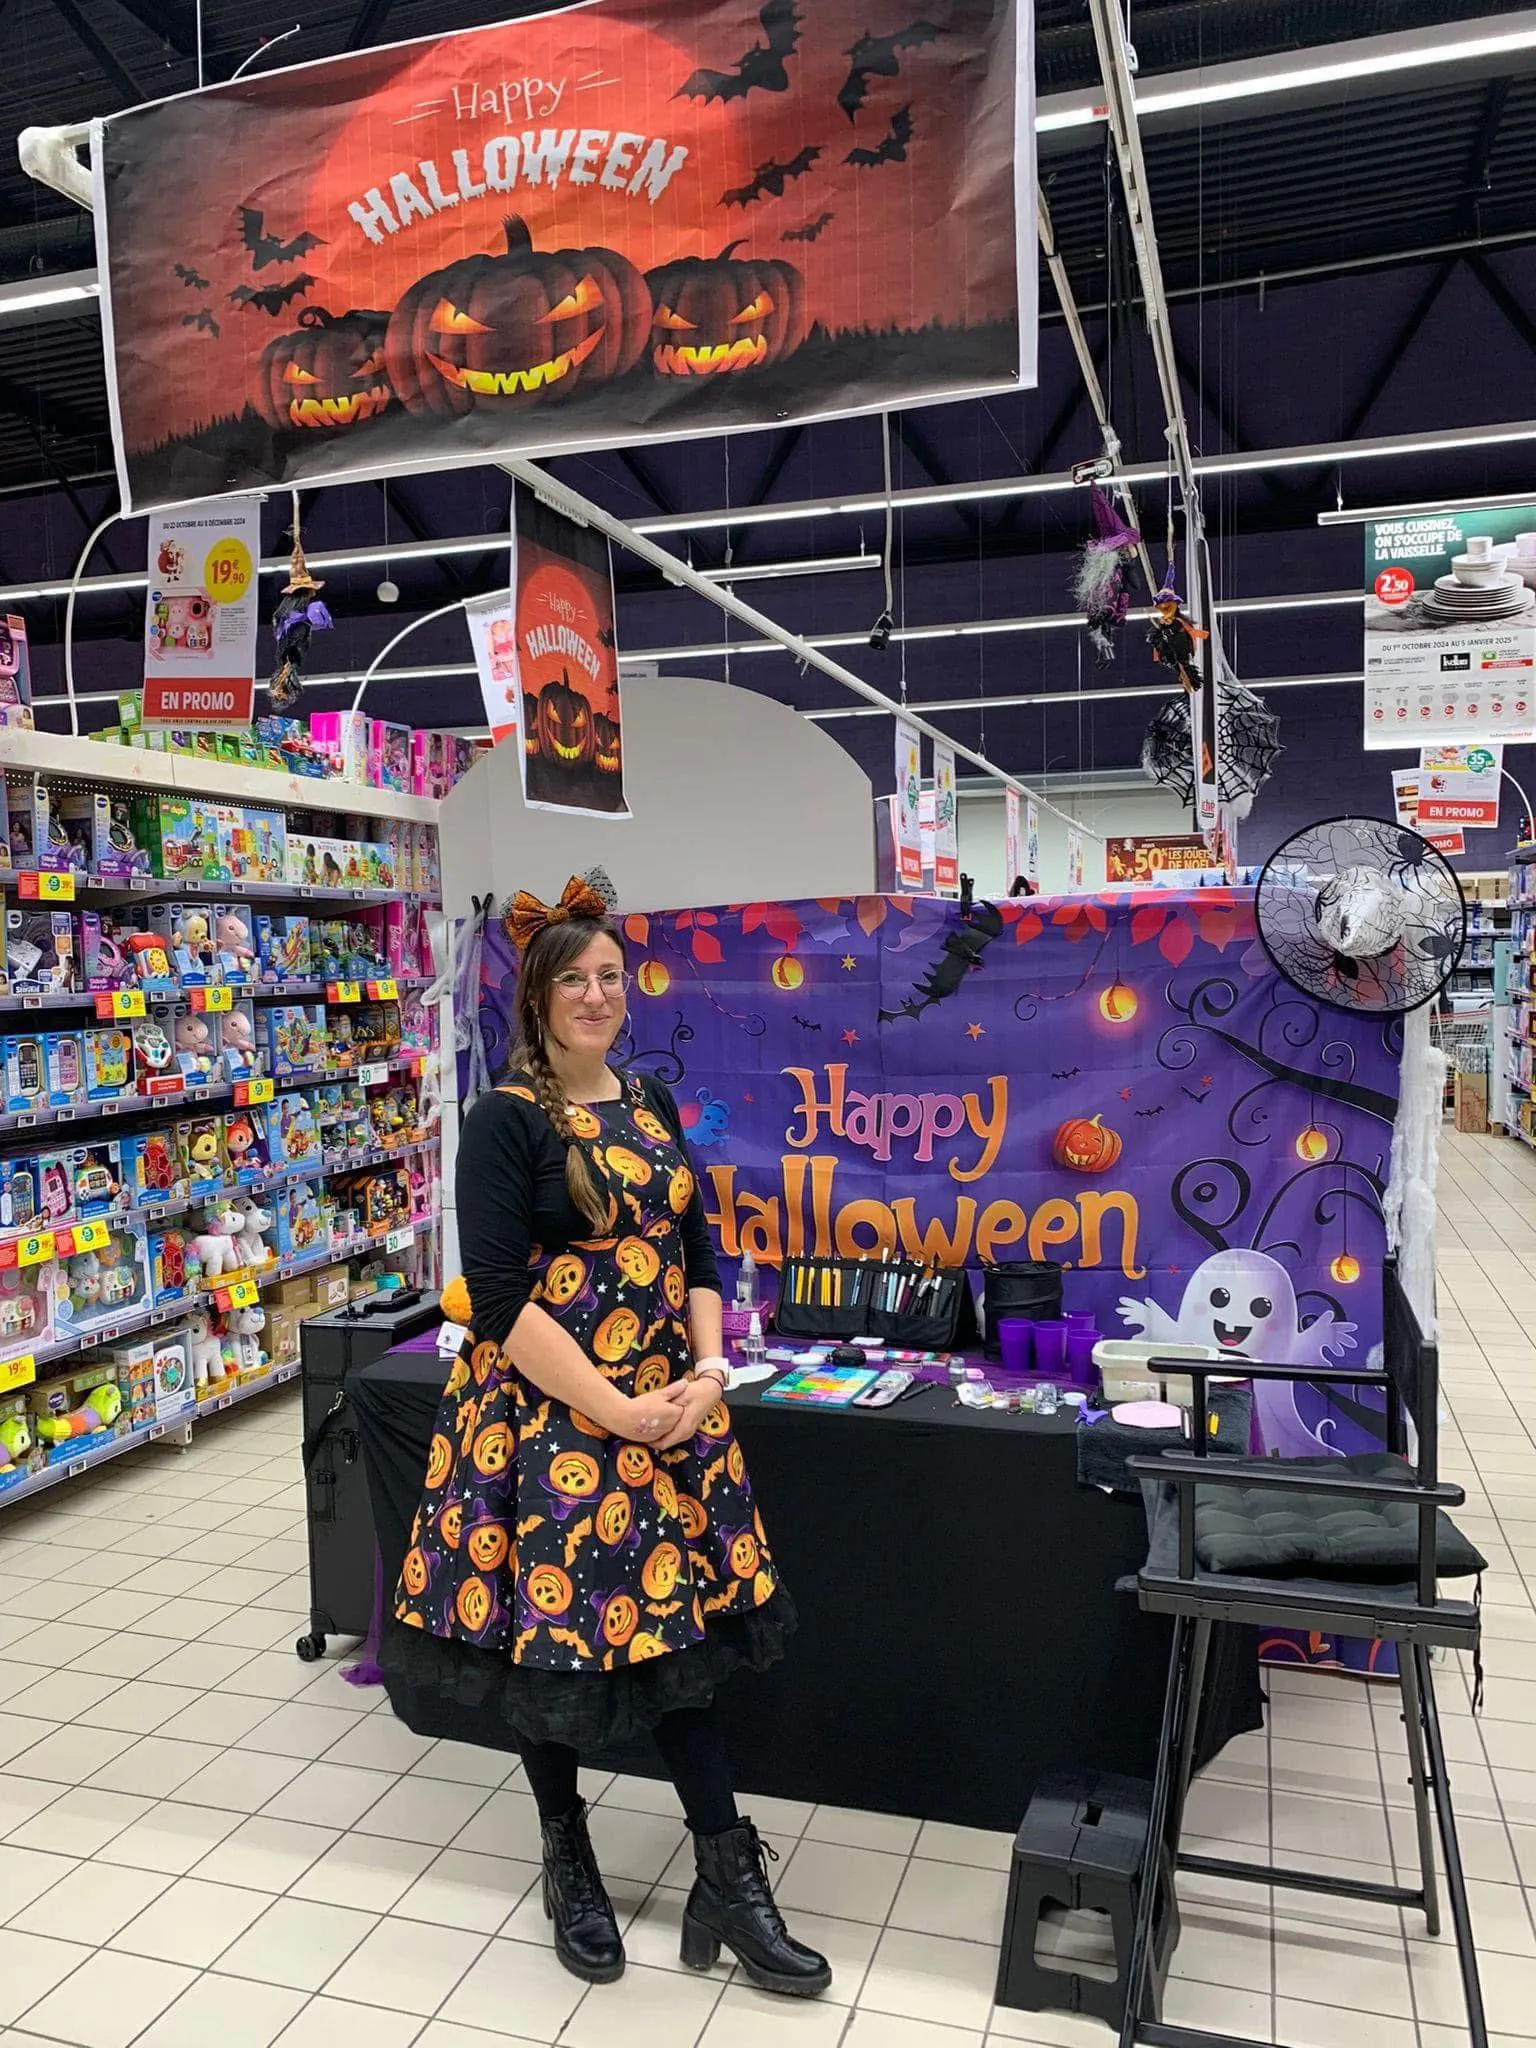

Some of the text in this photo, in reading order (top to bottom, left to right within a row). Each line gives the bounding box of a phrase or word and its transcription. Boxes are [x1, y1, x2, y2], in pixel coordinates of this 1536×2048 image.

[451, 75, 568, 125] Happy
[346, 128, 690, 246] HALLOWEEN
[176, 520, 197, 529] OCTOBRE
[1374, 518, 1458, 536] VOUS CUISINEZ,
[1374, 529, 1463, 549] ON S'OCCUPE DE
[1374, 543, 1447, 561] LA VAISSELLE.
[549, 591, 576, 624] Happy
[525, 623, 601, 682] HALLOWEEN
[1382, 644, 1392, 652] DU
[1401, 642, 1432, 651] OCTOBRE
[1433, 641, 1449, 649] 2024
[1451, 640, 1460, 648] AU
[1467, 638, 1494, 647] JANVIER
[1495, 636, 1512, 645] 2025
[161, 691, 235, 711] EN PROMO
[1429, 806, 1484, 818] EN PROMO
[1168, 849, 1181, 860] LES
[779, 1063, 1008, 1183] Happy
